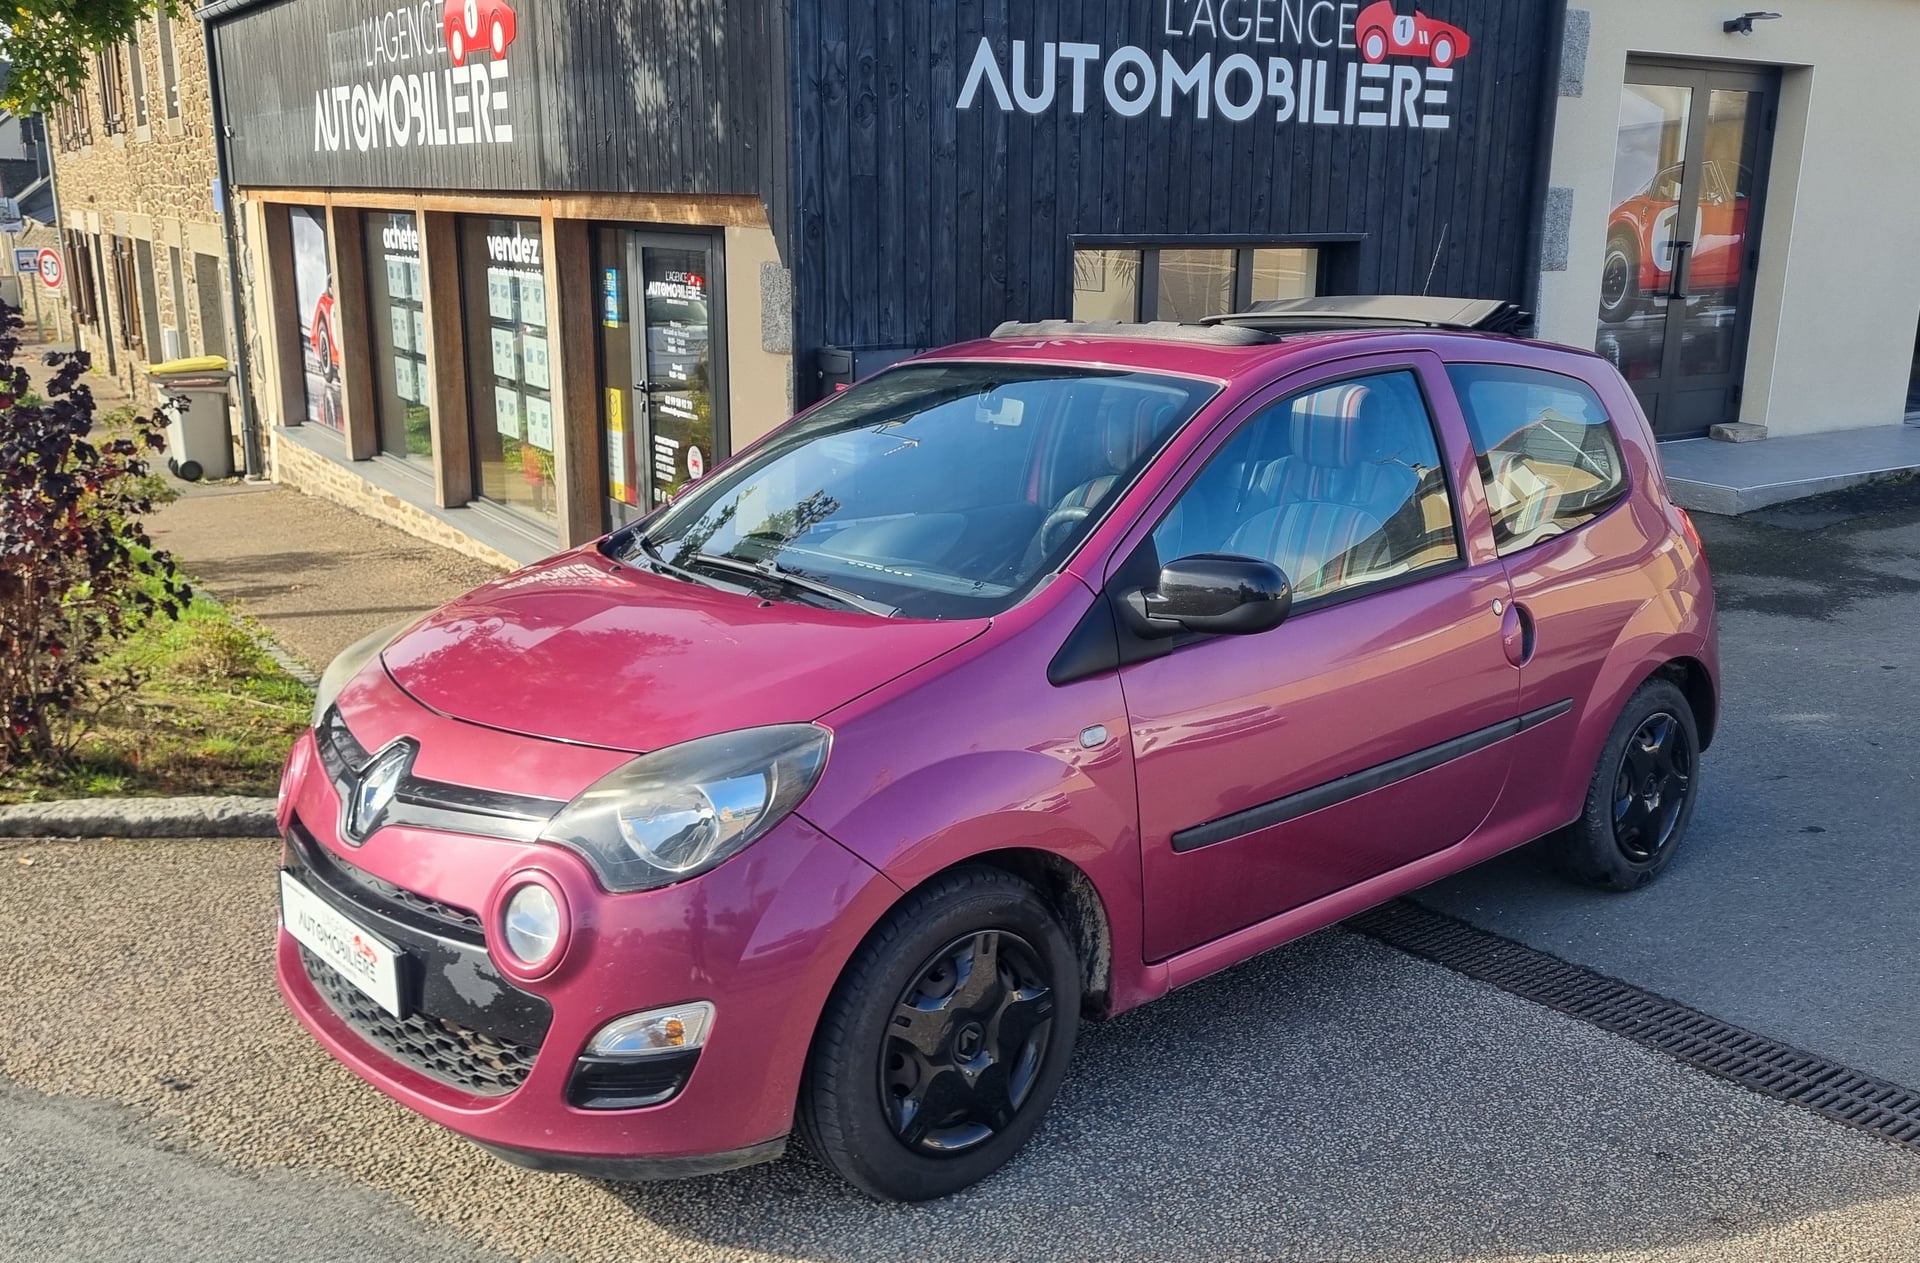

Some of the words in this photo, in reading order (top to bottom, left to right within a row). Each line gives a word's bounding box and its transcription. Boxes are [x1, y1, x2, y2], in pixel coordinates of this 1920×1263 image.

[362, 0, 447, 67] L'AGENCE
[1164, 0, 1358, 49] LAGENCE
[314, 59, 513, 152] AUTOMOBILIERE
[955, 36, 1453, 129] AUTOMOBILIERE
[382, 222, 418, 252] achete
[486, 228, 541, 265] vendez
[43, 260, 58, 276] 50
